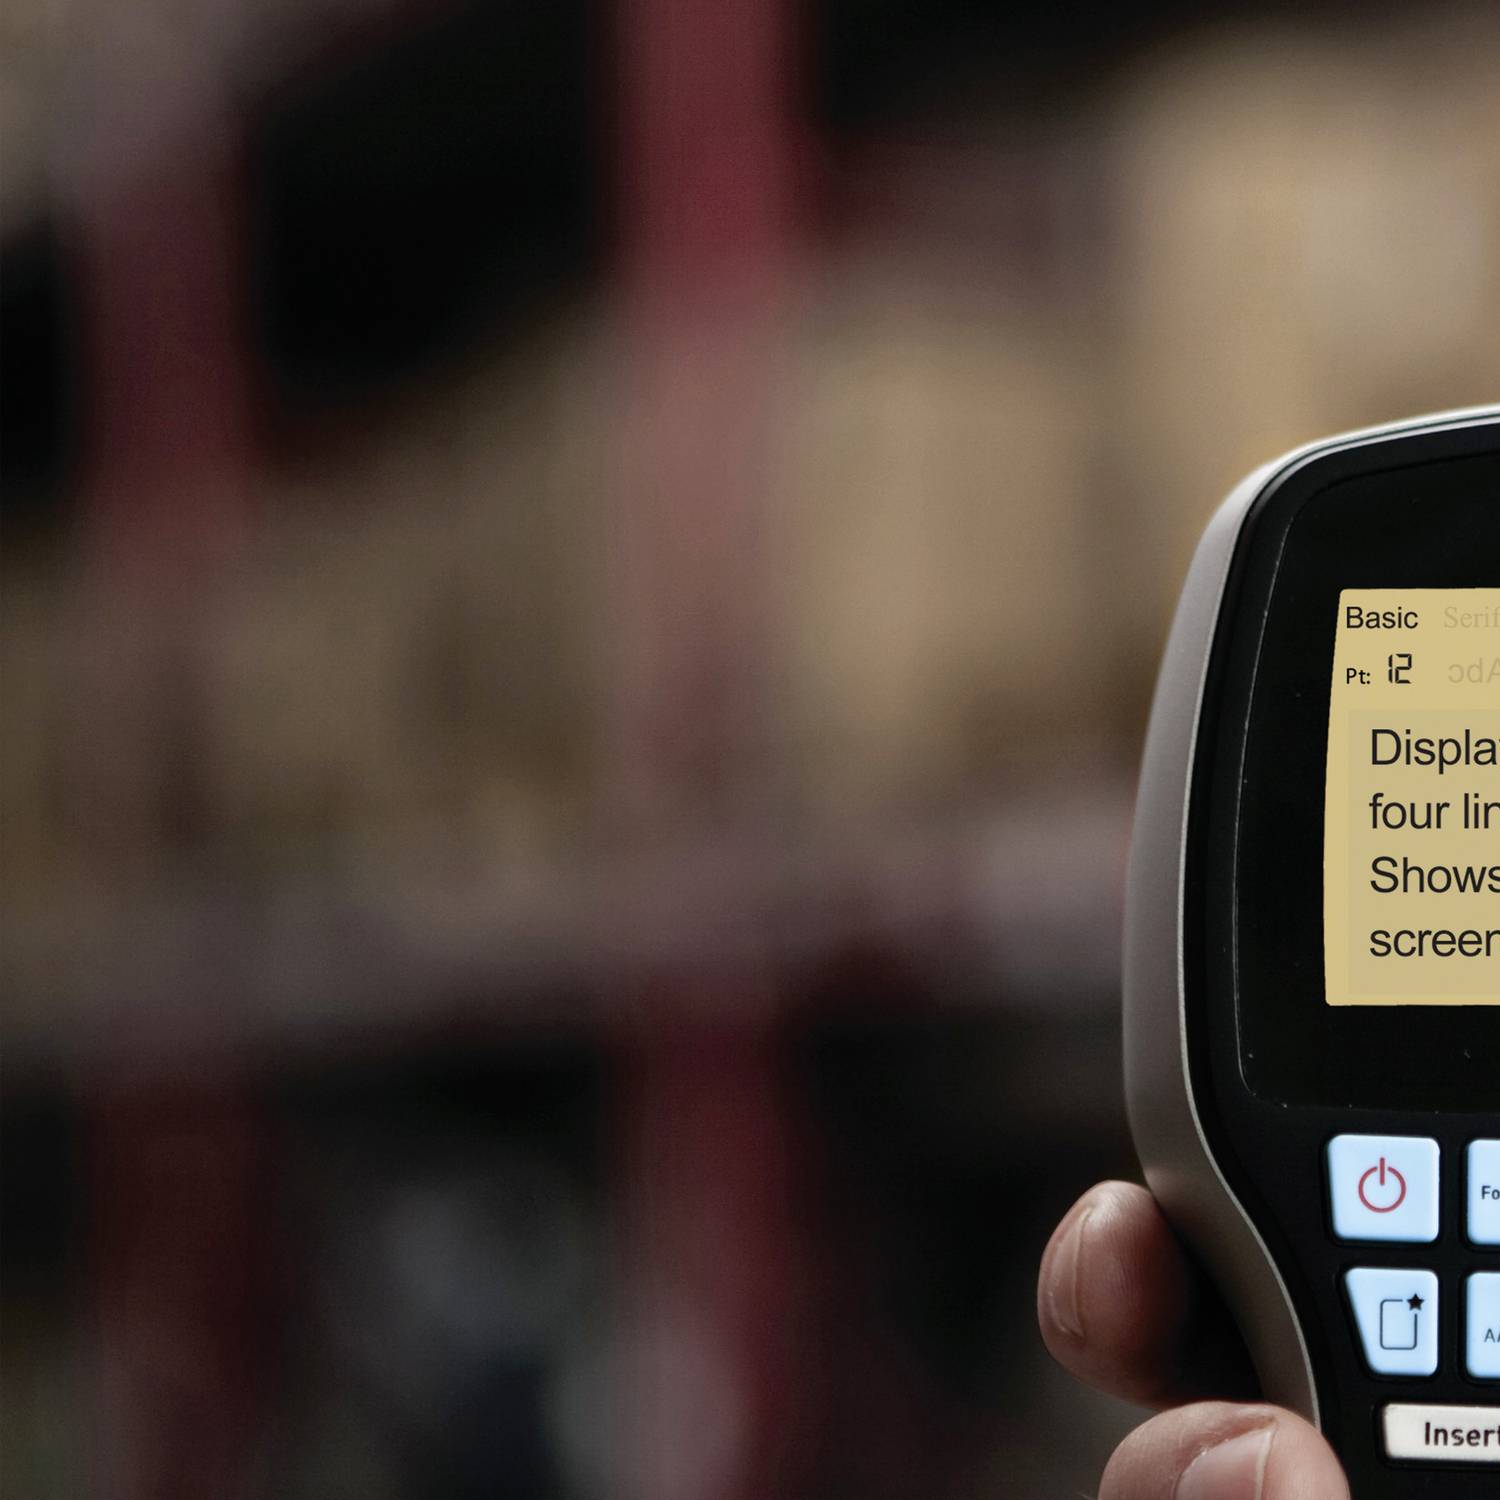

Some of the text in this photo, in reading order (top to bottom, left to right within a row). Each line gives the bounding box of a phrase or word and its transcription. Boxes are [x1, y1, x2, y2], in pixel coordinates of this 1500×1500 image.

[1346, 606, 1418, 630] Basic
[1346, 653, 1413, 685] Pt: 12
[1369, 792, 1450, 830] four
